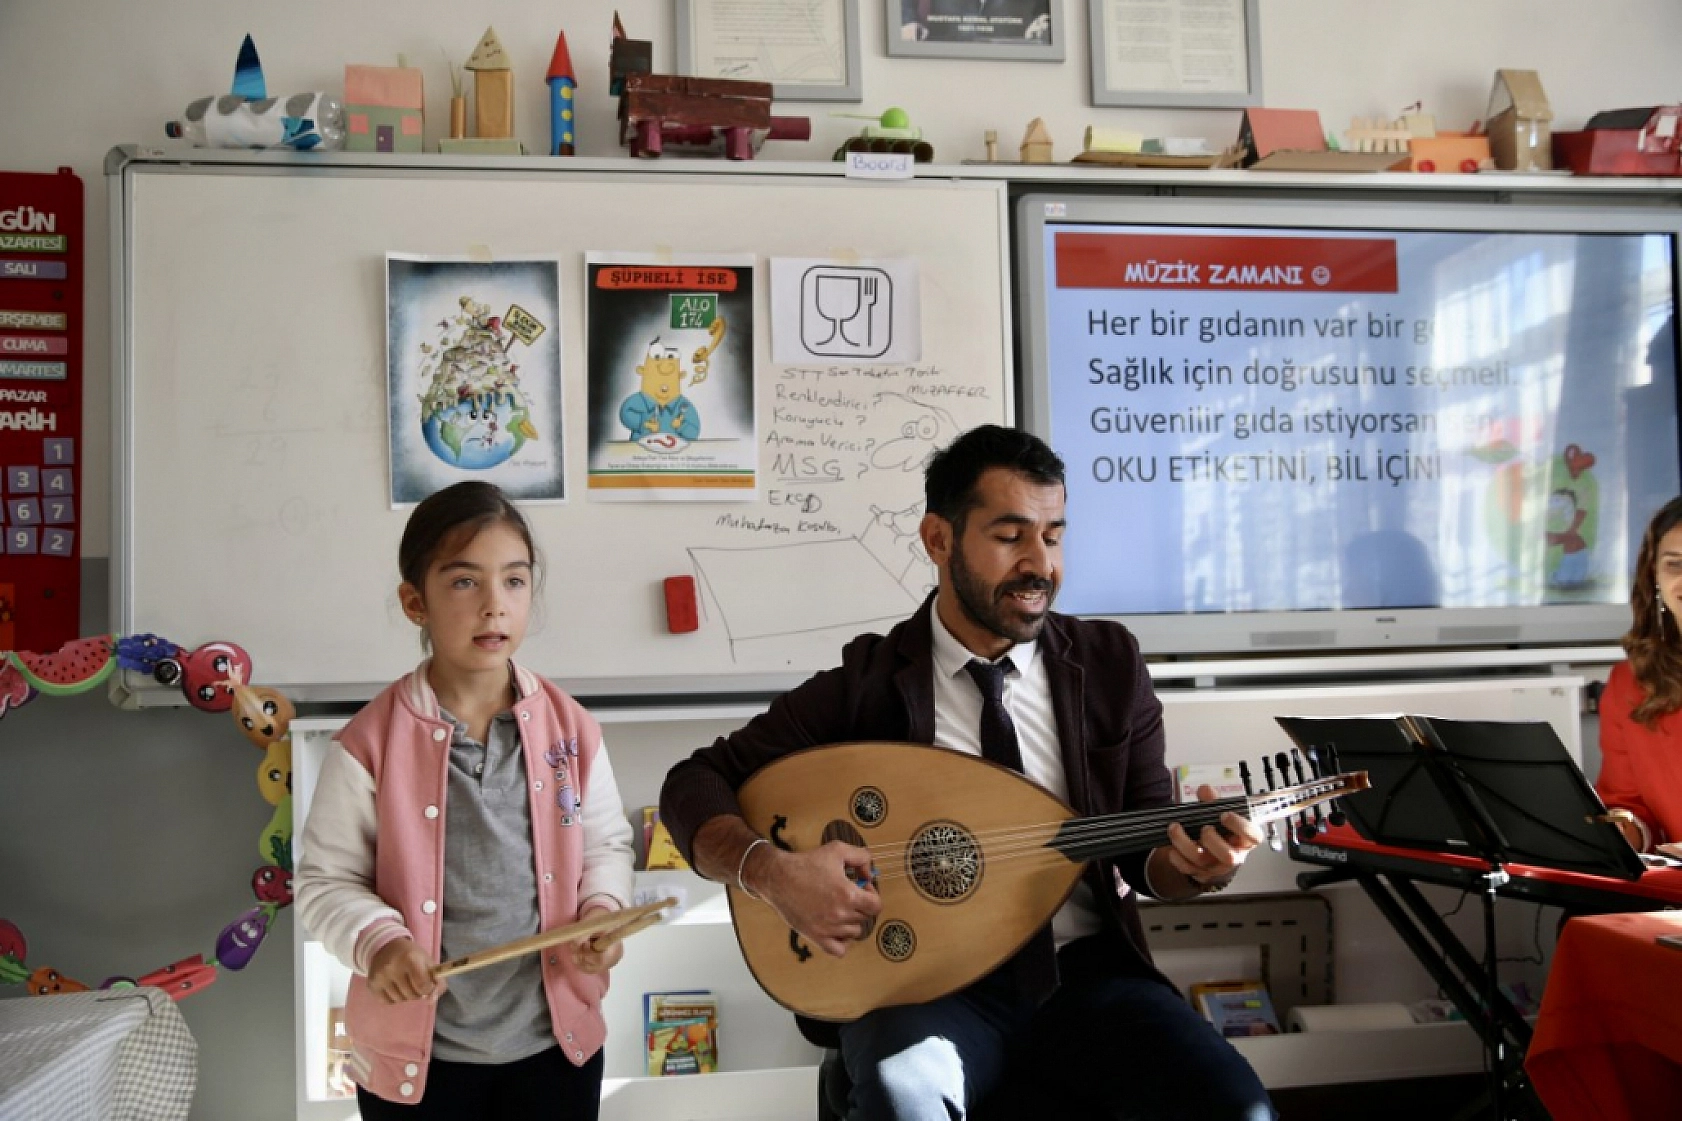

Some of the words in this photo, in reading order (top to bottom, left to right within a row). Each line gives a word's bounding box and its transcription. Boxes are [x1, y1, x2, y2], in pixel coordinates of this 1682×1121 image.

[852, 153, 908, 172] Board
[0, 205, 56, 233] GÜN
[4, 262, 37, 276] SALI
[610, 267, 683, 286] ŞÜPHELİ
[697, 268, 728, 285] İSE
[1124, 259, 1200, 284] MÜZİK
[1208, 263, 1304, 285] ZAMANI
[679, 297, 711, 313] ALO
[1087, 309, 1142, 337] Her
[1151, 308, 1191, 336] bir
[1199, 309, 1306, 344] gıdanın
[1313, 317, 1358, 339] var
[1366, 311, 1405, 339] bir
[3, 338, 48, 352] CUMA
[0, 361, 66, 378] MARTESİ
[1088, 356, 1175, 391] Sağlık
[1183, 358, 1233, 391] için
[1243, 358, 1397, 391] doğrusunu
[0, 388, 48, 403] PAZAR
[905, 383, 990, 400] MUZAFFER
[0, 406, 57, 432] ARİH
[1089, 405, 1225, 434] Güvenilir
[1233, 405, 1294, 440] gıda
[1304, 406, 1437, 439] istiyorsan
[53, 443, 63, 460] 1
[771, 452, 842, 480] MSG
[1091, 454, 1158, 484] OKU
[1168, 449, 1316, 486] ETİKETİNİ,
[1326, 449, 1369, 482] BİL
[17, 471, 30, 488] 3
[50, 474, 65, 491] 4
[17, 503, 31, 519] 6
[51, 503, 65, 519] 7
[15, 531, 29, 548] 9
[50, 534, 64, 551] 2
